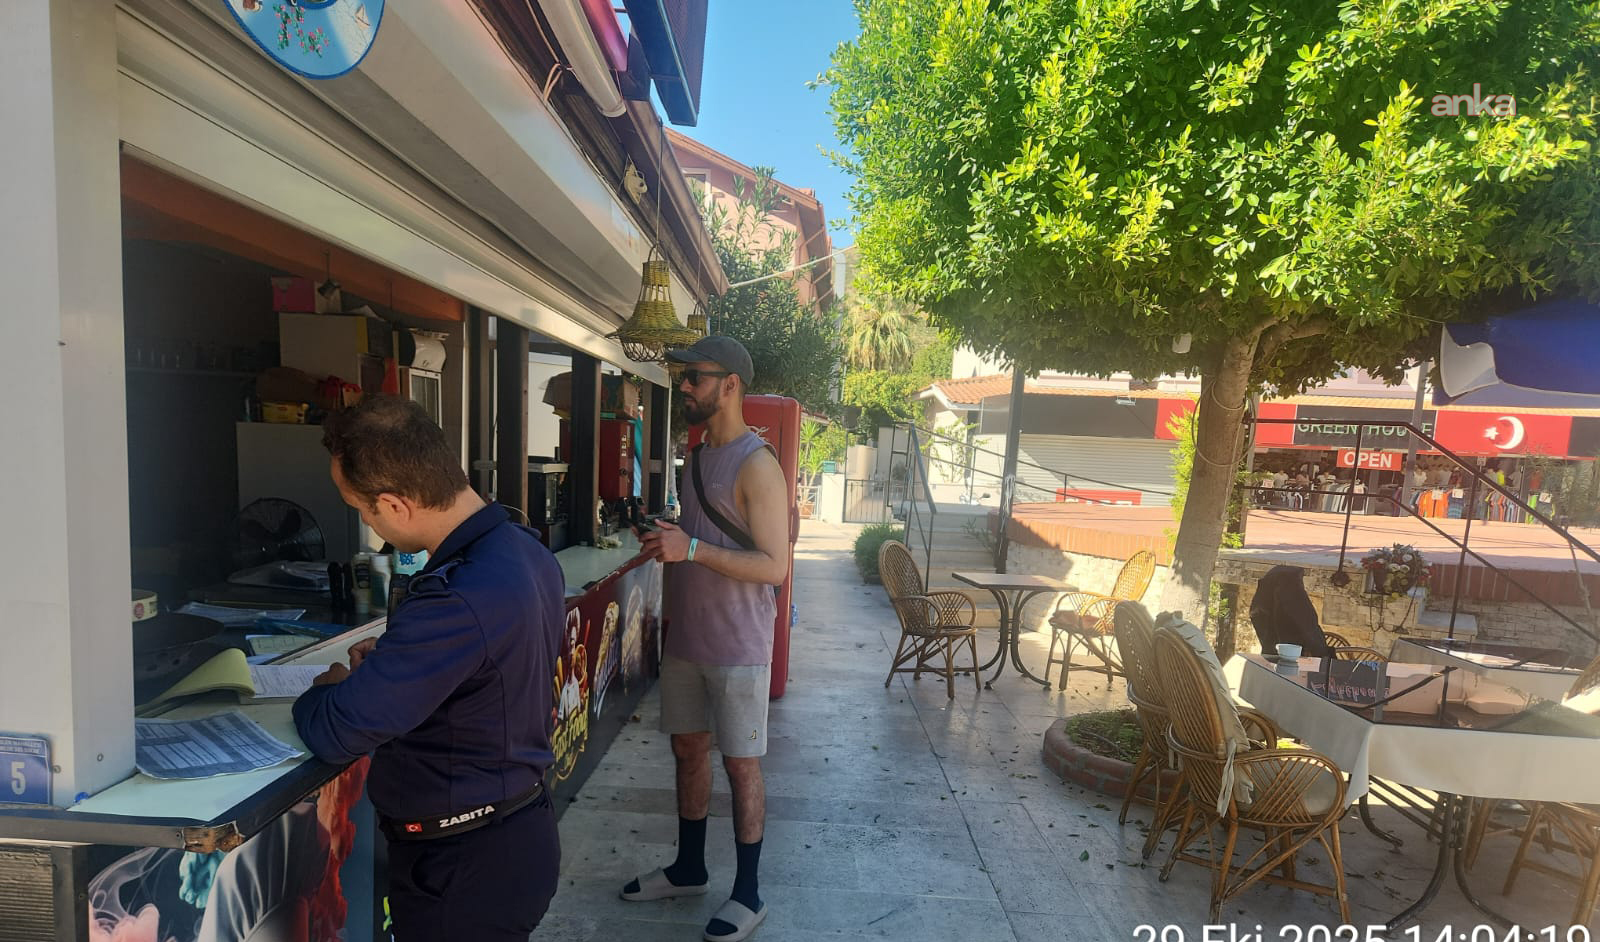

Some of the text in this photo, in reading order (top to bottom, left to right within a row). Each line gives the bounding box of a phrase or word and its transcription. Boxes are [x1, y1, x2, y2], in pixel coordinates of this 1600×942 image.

[1297, 418, 1433, 438] GREEN HOUE
[1343, 452, 1393, 468] OPEN
[11, 761, 26, 795] 5
[439, 805, 495, 828] ZABITA
